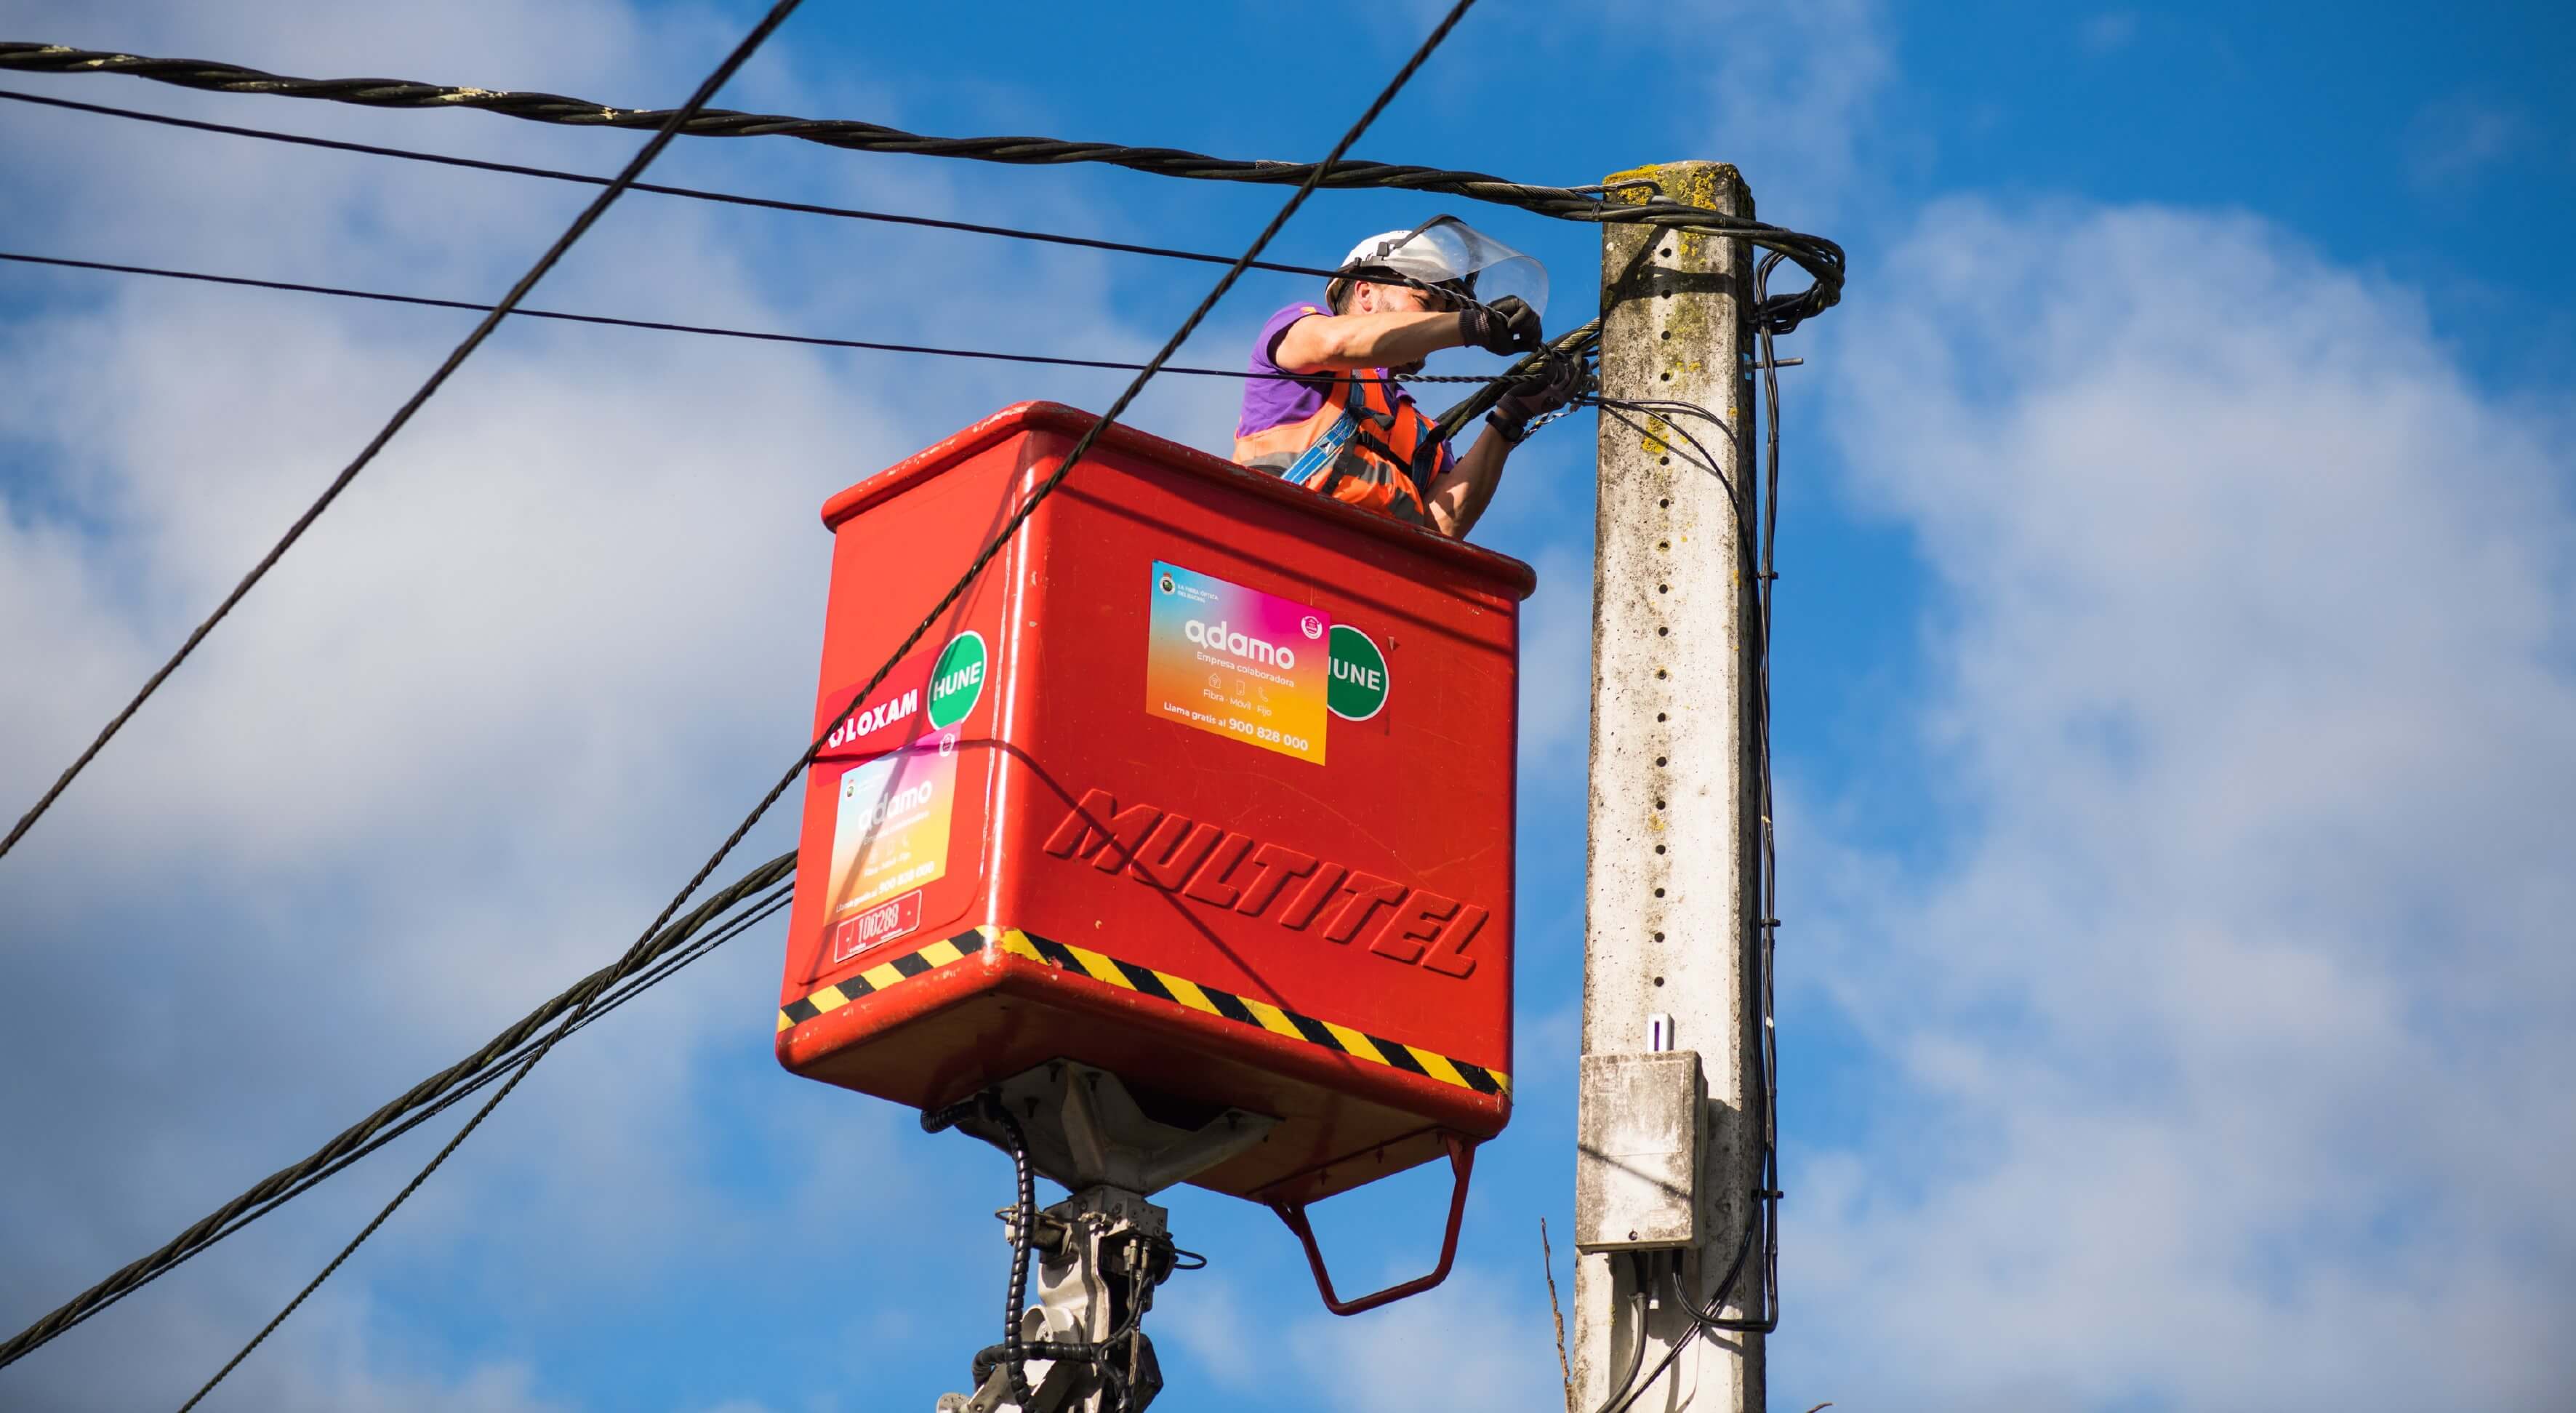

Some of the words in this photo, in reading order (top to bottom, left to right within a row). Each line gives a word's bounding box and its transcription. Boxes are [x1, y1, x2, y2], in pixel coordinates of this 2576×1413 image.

[1185, 620, 1295, 670] adamo
[933, 661, 982, 701] HUNE
[1197, 652, 1235, 670] Empresa
[1237, 665, 1295, 687] colaboradora
[1328, 656, 1381, 692] UNE
[846, 689, 918, 742] LOXAM
[1203, 689, 1224, 703] Fibra
[1230, 697, 1251, 710] Móvil
[1257, 705, 1272, 716] Fijo
[1164, 701, 1190, 717] Llama
[1192, 711, 1216, 725] gratis
[1218, 719, 1226, 728] al
[1229, 718, 1253, 735] 900
[1256, 727, 1280, 743] 828
[1283, 734, 1309, 751] 000
[859, 780, 933, 830] adamo
[1043, 788, 1489, 980] MULTITEL
[859, 903, 899, 943] 100288
